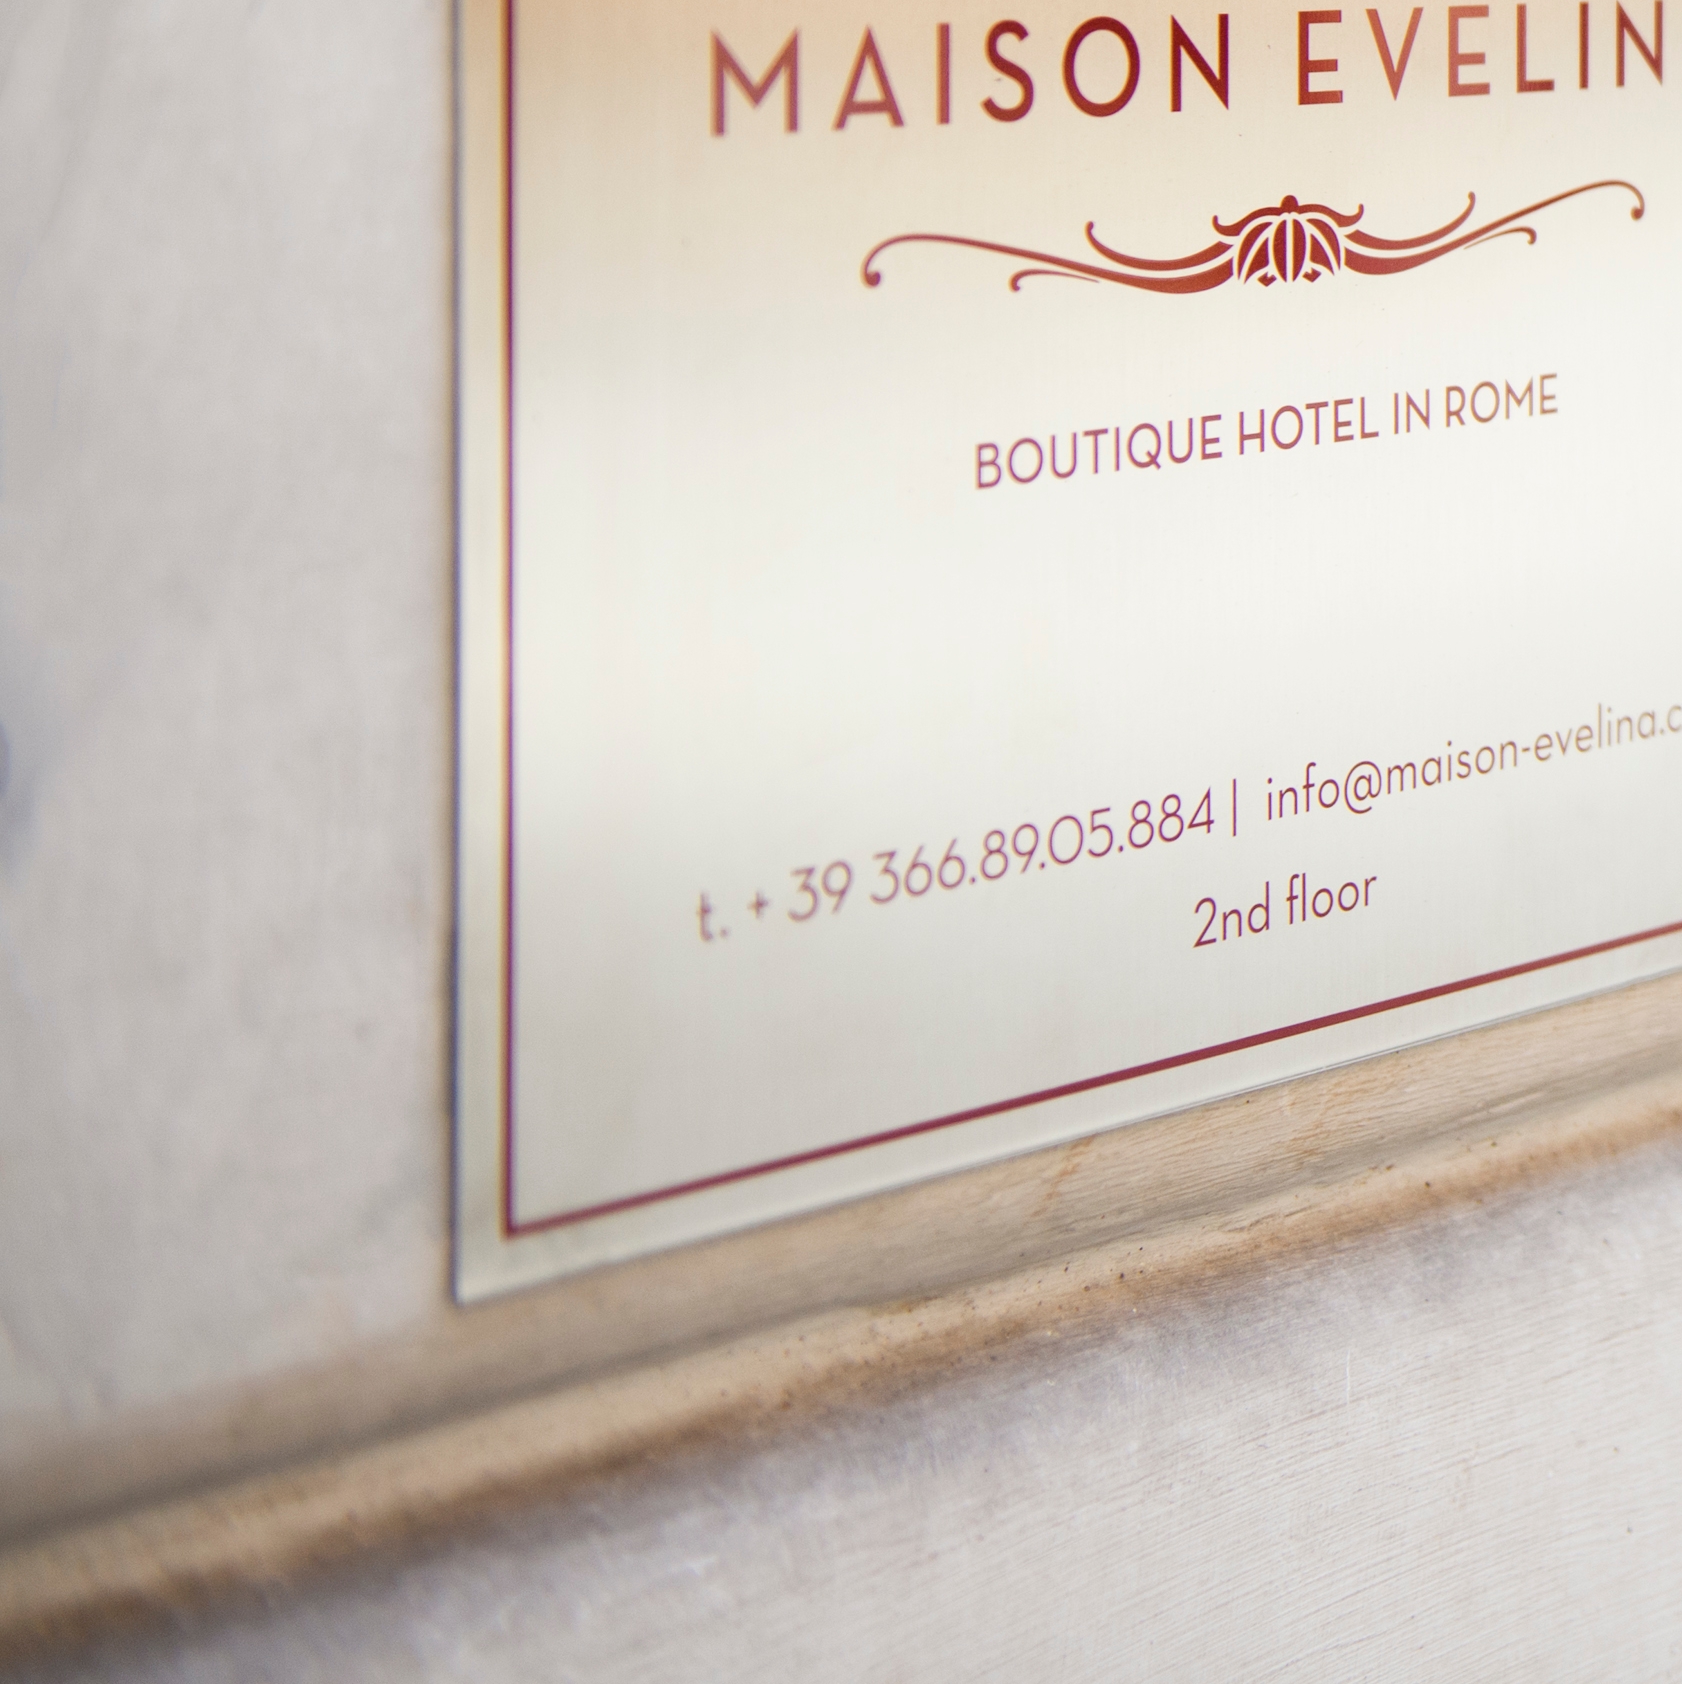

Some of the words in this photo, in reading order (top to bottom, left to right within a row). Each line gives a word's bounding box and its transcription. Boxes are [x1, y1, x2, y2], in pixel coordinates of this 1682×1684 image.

[709, 13, 1230, 137] MAISON
[975, 414, 1223, 489] BOUTIQUE
[1239, 397, 1379, 455] HOTEL
[1394, 389, 1430, 435] IN
[1445, 373, 1558, 427] ROME
[695, 891, 729, 942] t.
[787, 861, 853, 922] 39
[871, 787, 1215, 904] 366.89.05.884
[1192, 881, 1271, 948] 2nd
[1287, 870, 1377, 925] floor
